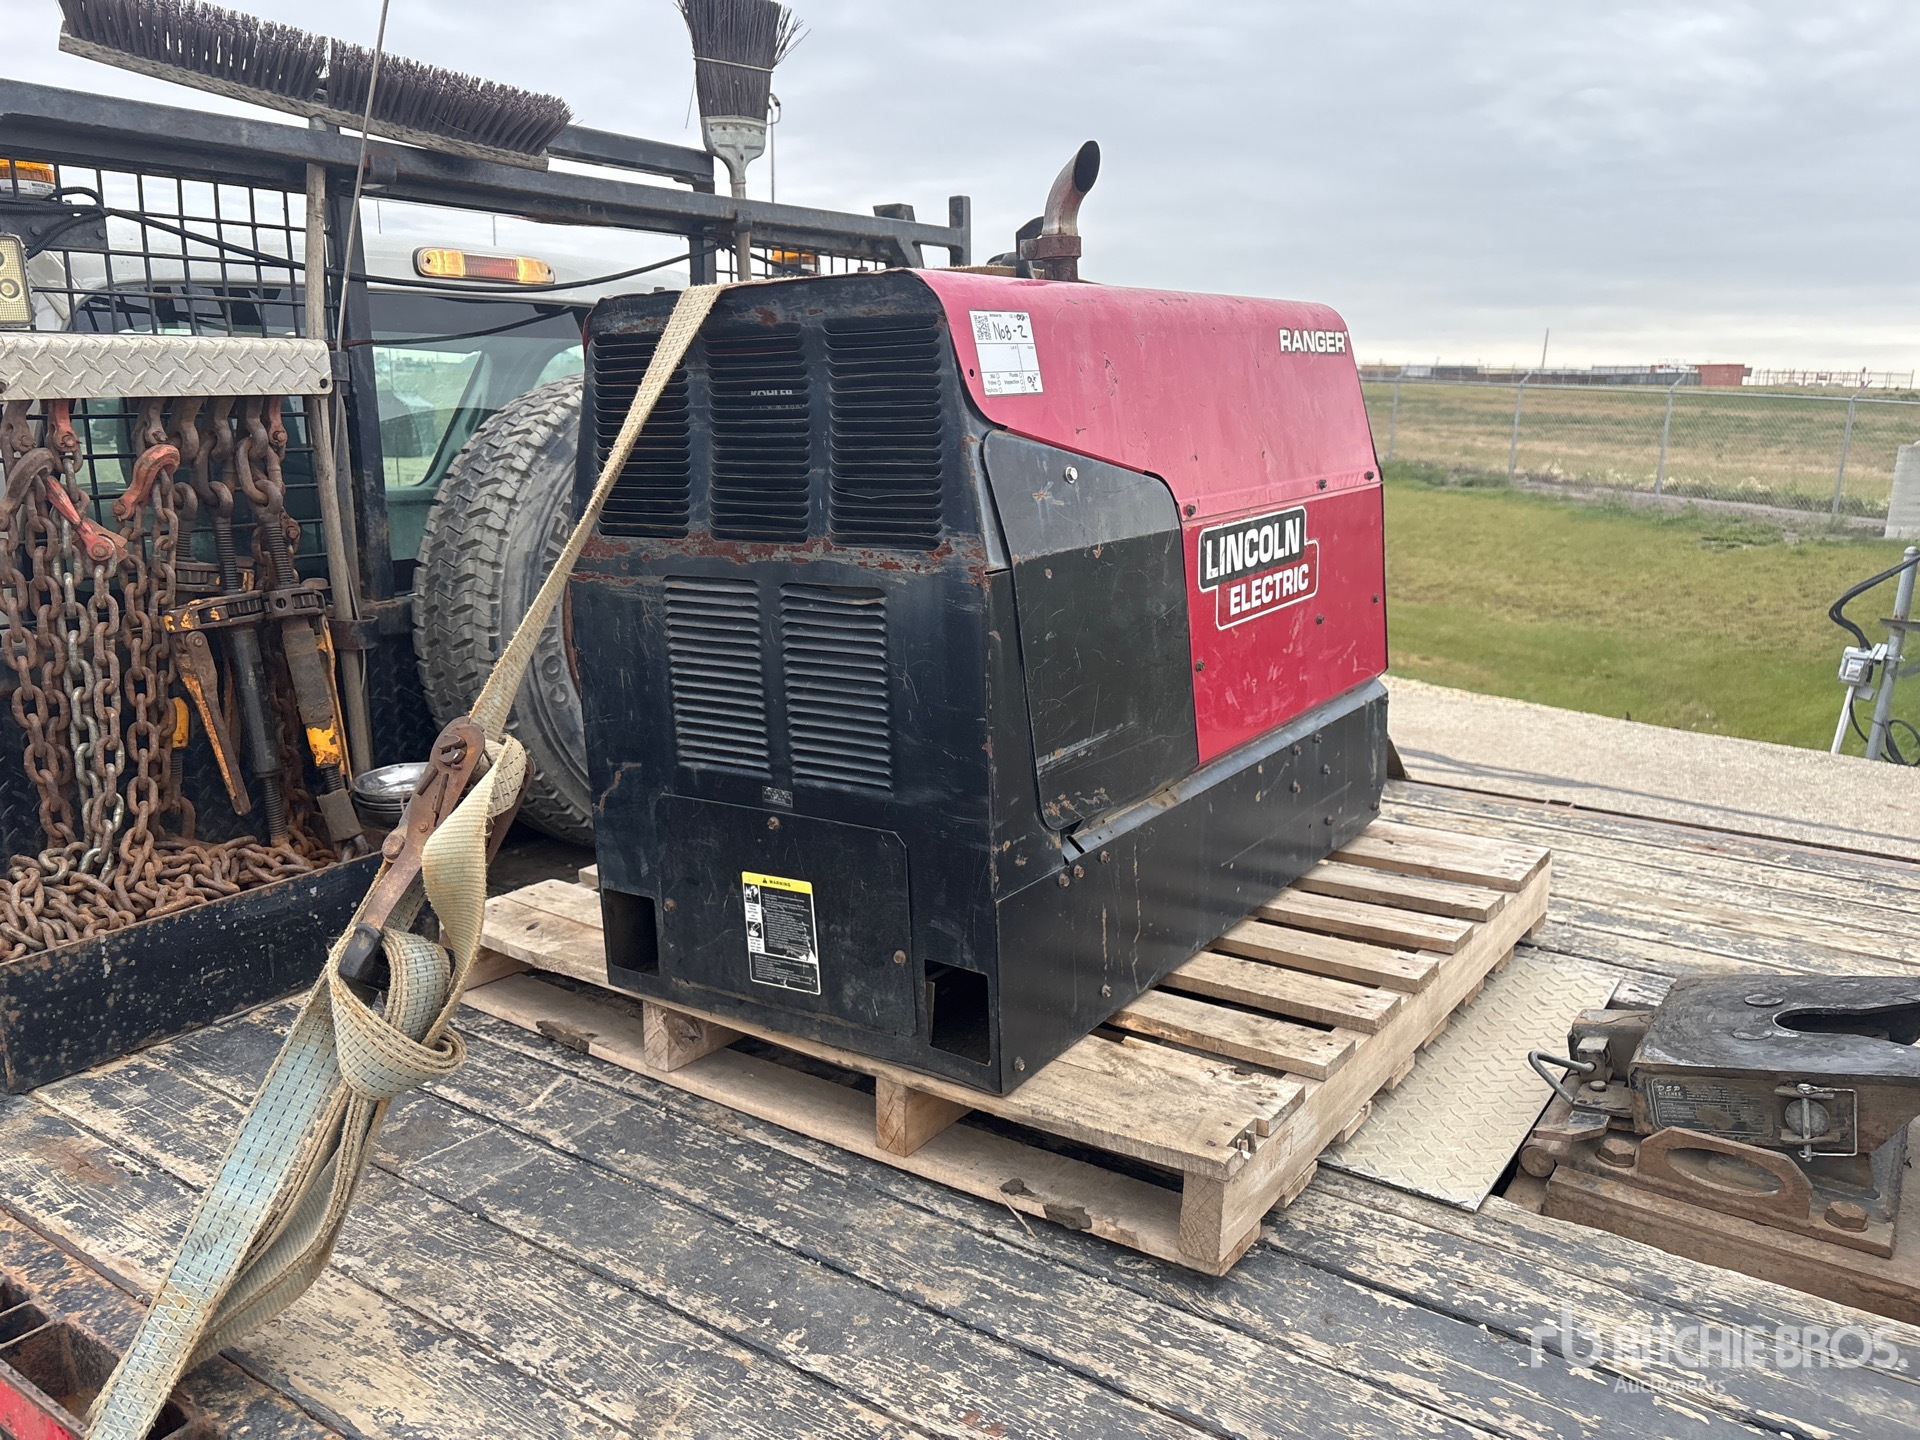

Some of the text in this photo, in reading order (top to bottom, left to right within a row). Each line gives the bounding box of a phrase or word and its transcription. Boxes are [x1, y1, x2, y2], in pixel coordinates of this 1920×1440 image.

[1279, 329, 1346, 353] RANGER
[1206, 517, 1301, 580] LINCOLN
[1230, 563, 1309, 616] ELECTRIC
[769, 879, 791, 888] WARNING
